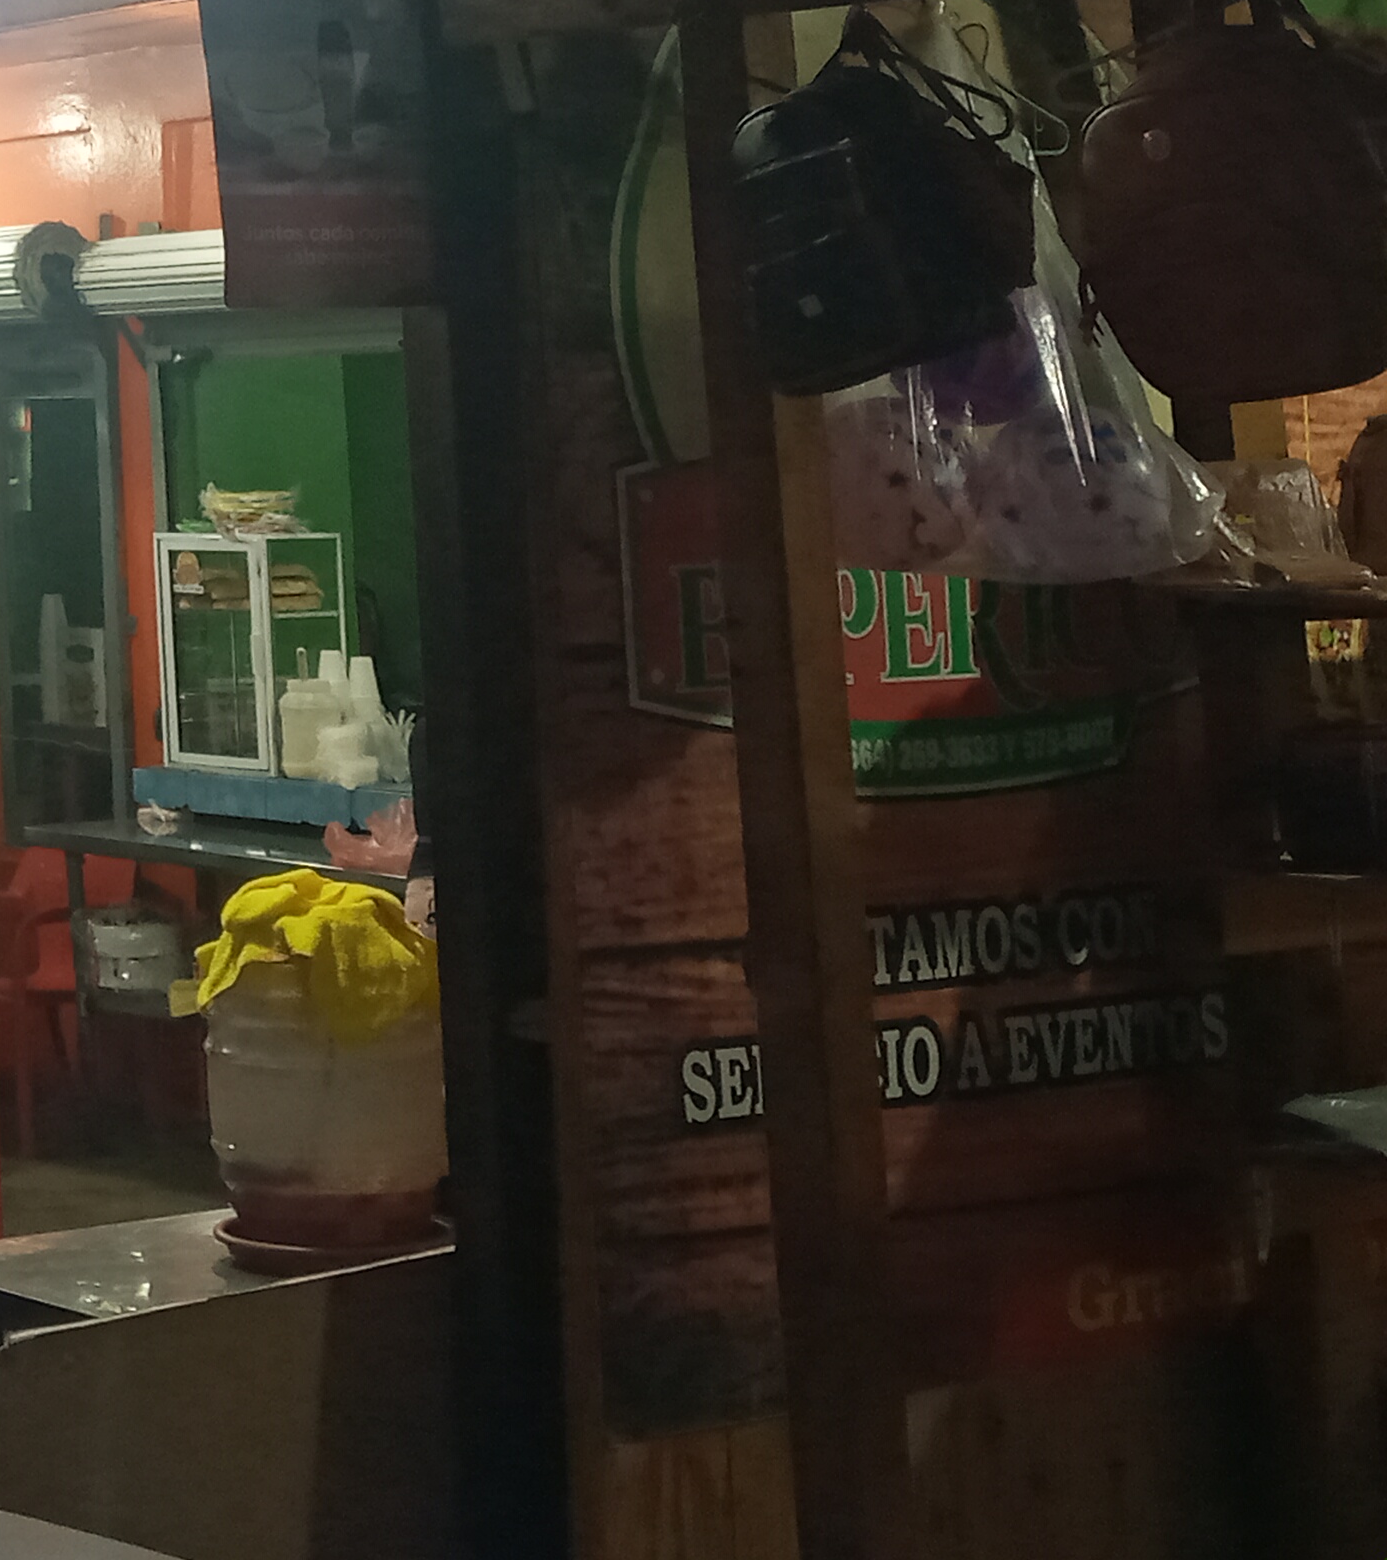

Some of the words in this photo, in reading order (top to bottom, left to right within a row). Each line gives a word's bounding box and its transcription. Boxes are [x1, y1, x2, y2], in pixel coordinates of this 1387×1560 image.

[865, 900, 1042, 986] TAMOS
[957, 1020, 992, 1091] A
[1003, 991, 1228, 1084] EVENTOS
